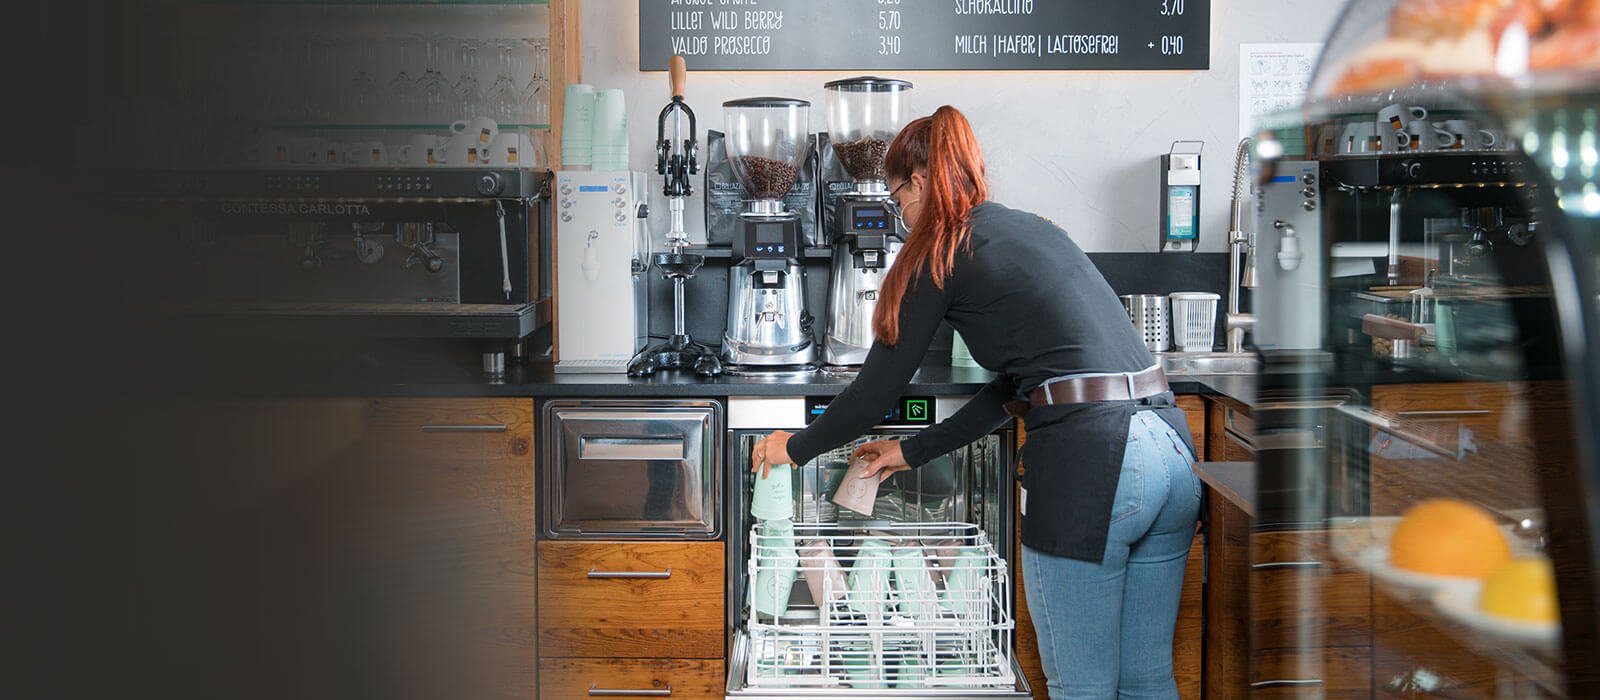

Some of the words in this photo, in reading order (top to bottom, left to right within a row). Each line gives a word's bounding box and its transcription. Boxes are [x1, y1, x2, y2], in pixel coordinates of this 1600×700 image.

[671, 11, 704, 30] LILLET
[710, 11, 738, 30] WILD
[744, 11, 783, 30] BERRY
[671, 36, 708, 55] VALDO
[714, 36, 771, 55] PROSECCO
[955, 34, 987, 54] MILCH
[1047, 34, 1119, 54] LACTOSEFREI
[222, 203, 297, 215] CONTESSA
[299, 204, 371, 216] CARLOTTA
